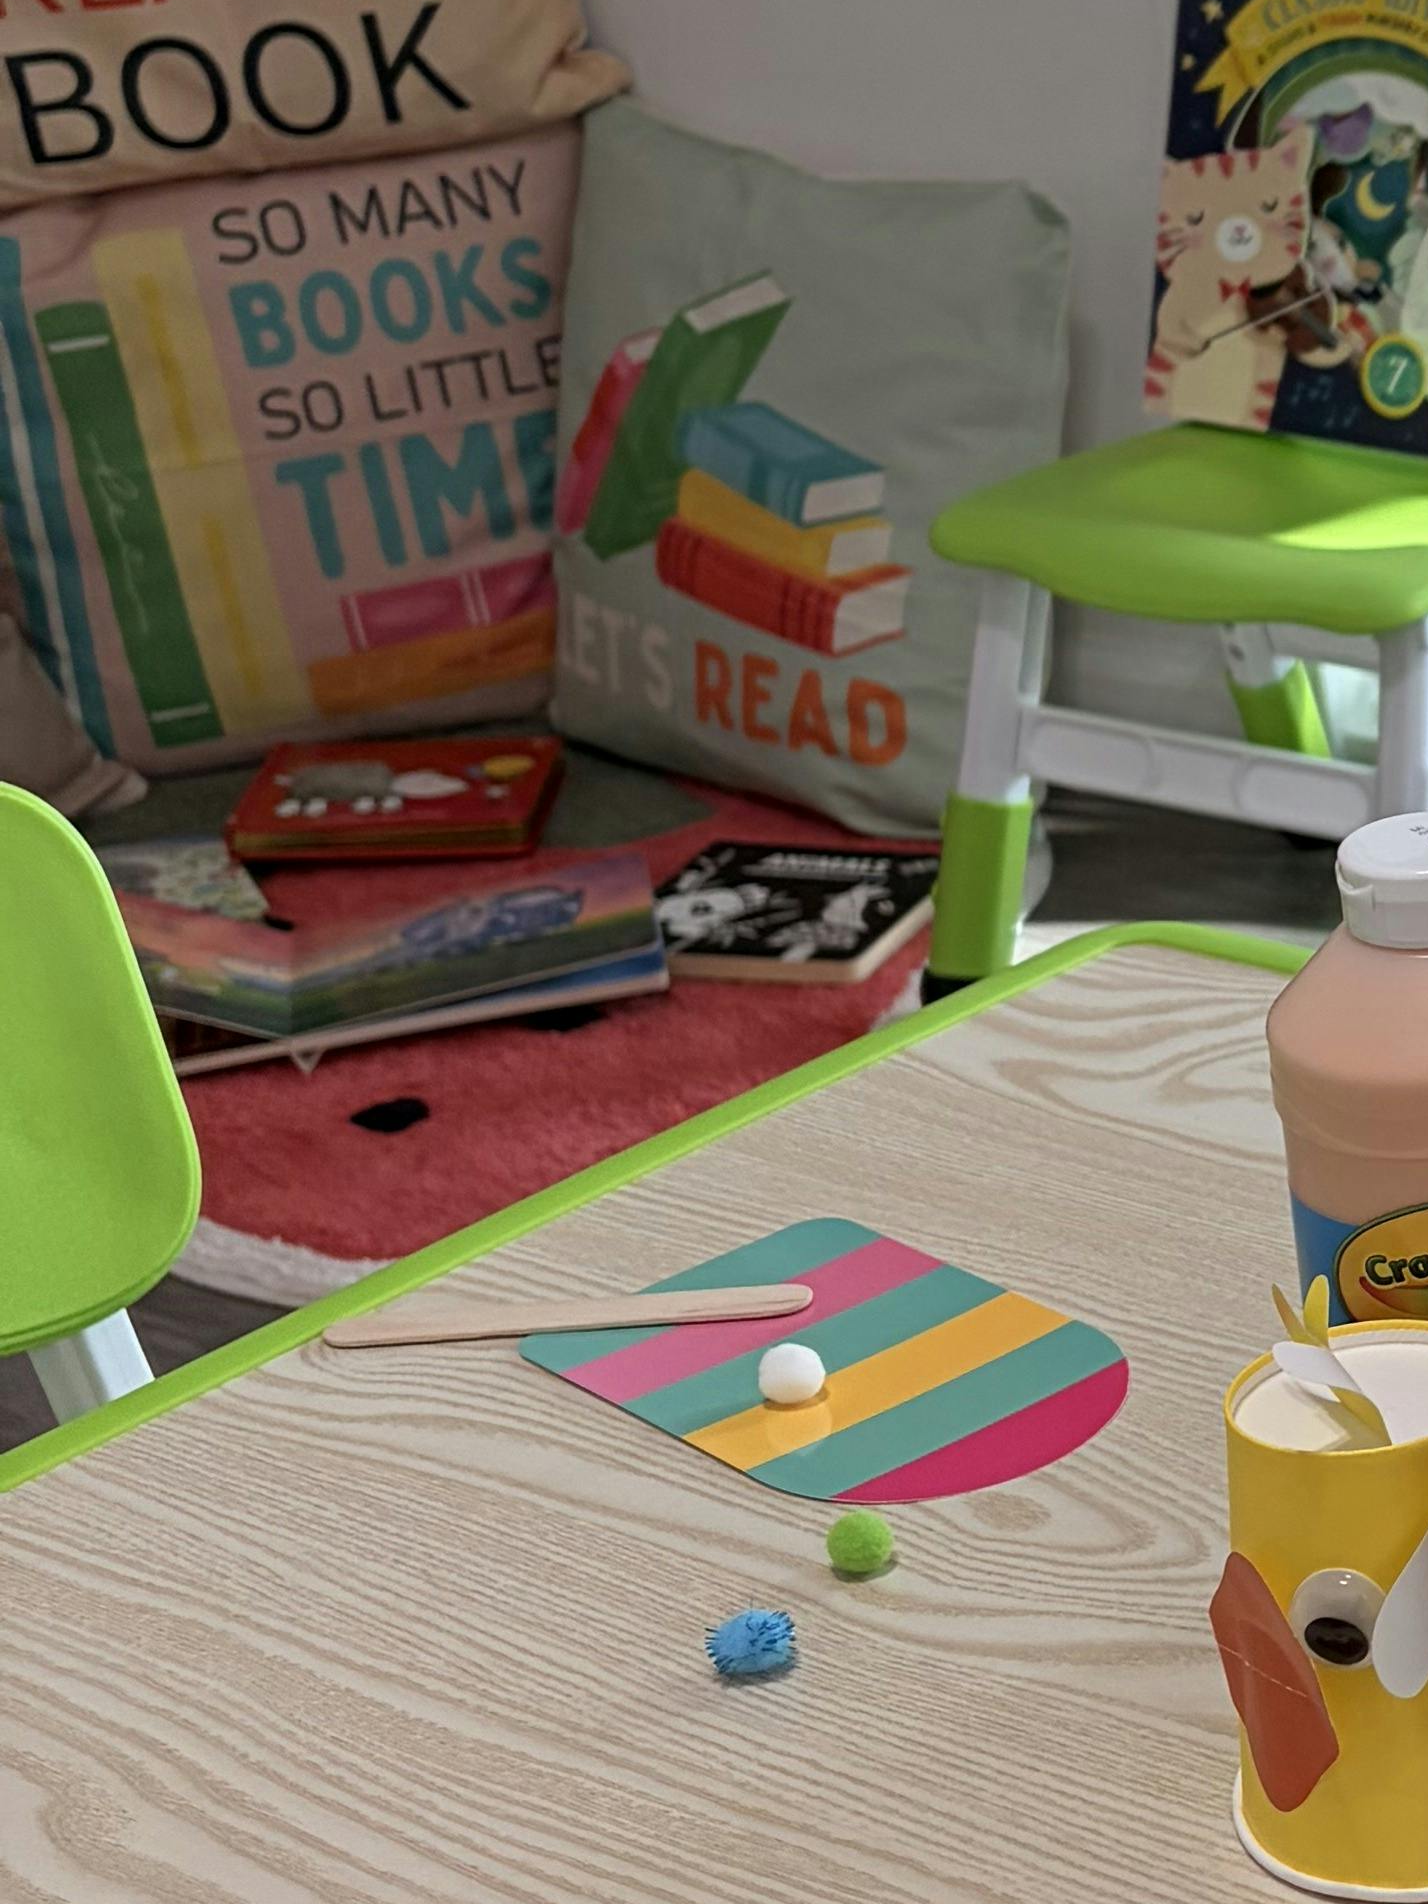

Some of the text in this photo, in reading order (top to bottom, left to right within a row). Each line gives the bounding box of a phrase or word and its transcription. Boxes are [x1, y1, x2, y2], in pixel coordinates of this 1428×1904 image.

[4, 0, 473, 165] BOOK
[211, 159, 524, 265] SO MANY
[228, 233, 552, 369] BOOKS
[258, 334, 561, 441] SO LITTLE
[694, 639, 907, 767] READ
